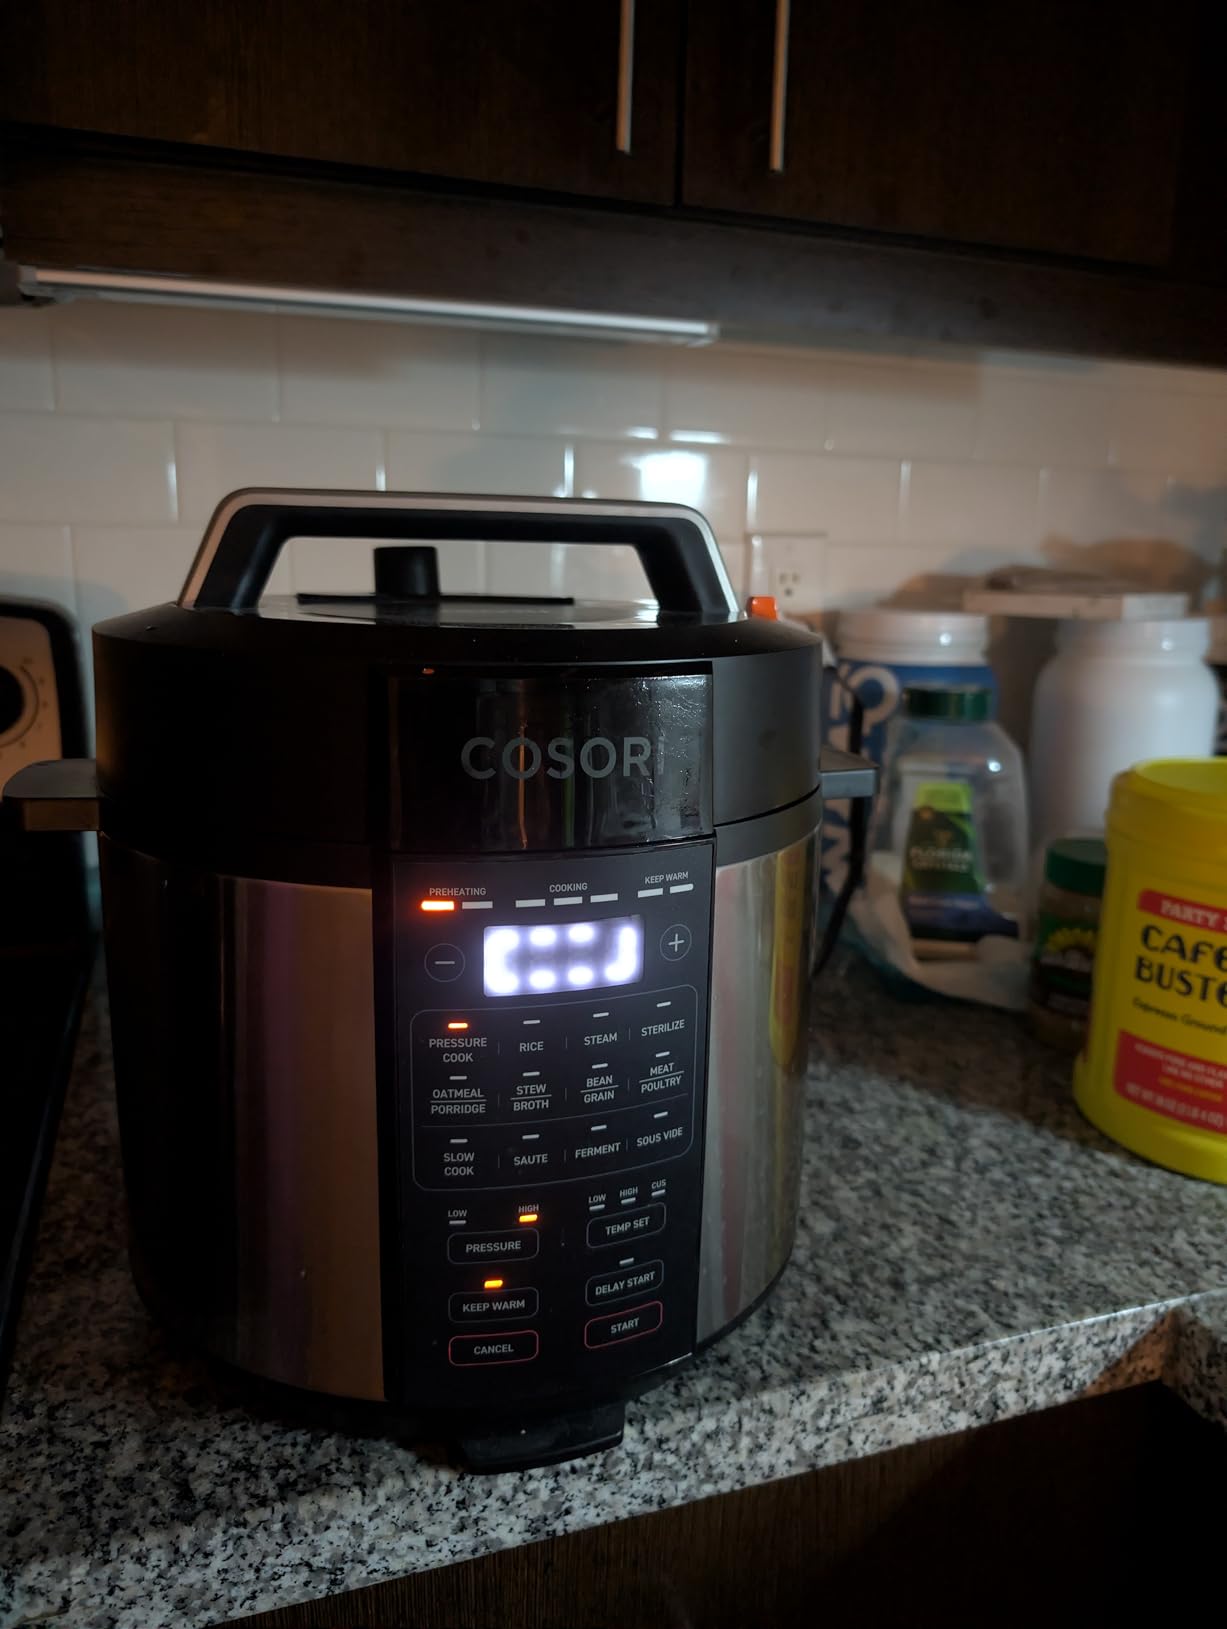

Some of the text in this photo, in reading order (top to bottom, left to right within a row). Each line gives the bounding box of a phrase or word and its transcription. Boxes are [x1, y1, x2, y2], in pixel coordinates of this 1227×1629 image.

[460, 736, 652, 780] COSOR
[644, 871, 689, 885] KEEP WARM
[429, 887, 487, 897] PREHEATING
[549, 882, 588, 893] COOKING
[1160, 898, 1221, 928] PARTY
[641, 1019, 685, 1037] STERILIZE
[428, 1037, 488, 1049] PRESSURE
[584, 1032, 618, 1046] STEAM
[519, 1041, 545, 1053] RICE
[442, 1053, 474, 1063] COOK
[649, 1063, 675, 1077] MEAT
[586, 1075, 614, 1088] BEAN
[640, 1075, 682, 1094] POULTRY
[432, 1088, 485, 1099] OATMEAL
[516, 1084, 547, 1096] STEW
[583, 1090, 615, 1104] GRAIN
[430, 1104, 487, 1115] PORRIDGE
[513, 1099, 549, 1112] BROTH
[636, 1127, 684, 1147] SOUS VIDE
[574, 1142, 621, 1159] FERMENT
[443, 1152, 475, 1163] SLOW
[513, 1154, 549, 1166] SAUTE
[444, 1166, 475, 1177] COOK
[651, 1179, 667, 1191] CUS
[588, 1194, 607, 1204] LOW
[619, 1187, 639, 1198] HIGH
[448, 1209, 468, 1218] LOW
[518, 1203, 540, 1214] HIGH
[605, 1216, 651, 1236] TEMP SET
[465, 1240, 522, 1253] PRESSURE
[595, 1271, 656, 1296] DELAY START
[462, 1299, 526, 1313] KEEP WARM
[610, 1317, 640, 1335] START
[473, 1343, 515, 1356] CANCEL
